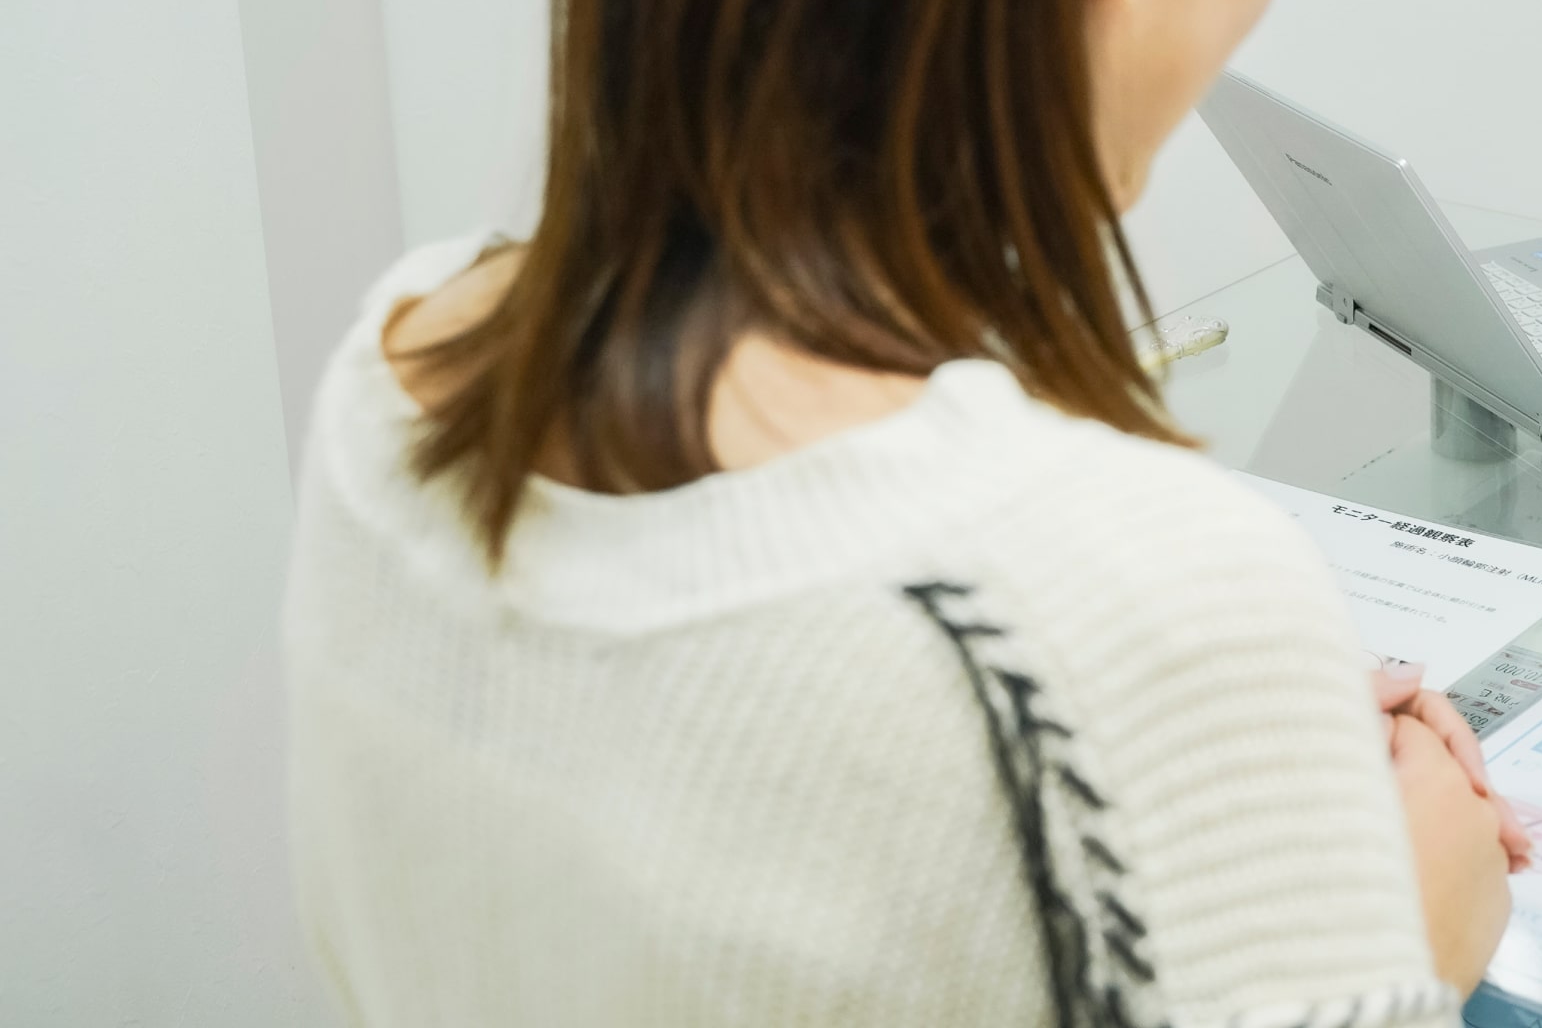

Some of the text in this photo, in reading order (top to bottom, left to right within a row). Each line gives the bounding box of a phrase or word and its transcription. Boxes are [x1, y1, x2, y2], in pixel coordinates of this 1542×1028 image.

[1332, 504, 1476, 549] モニター経過観察表
